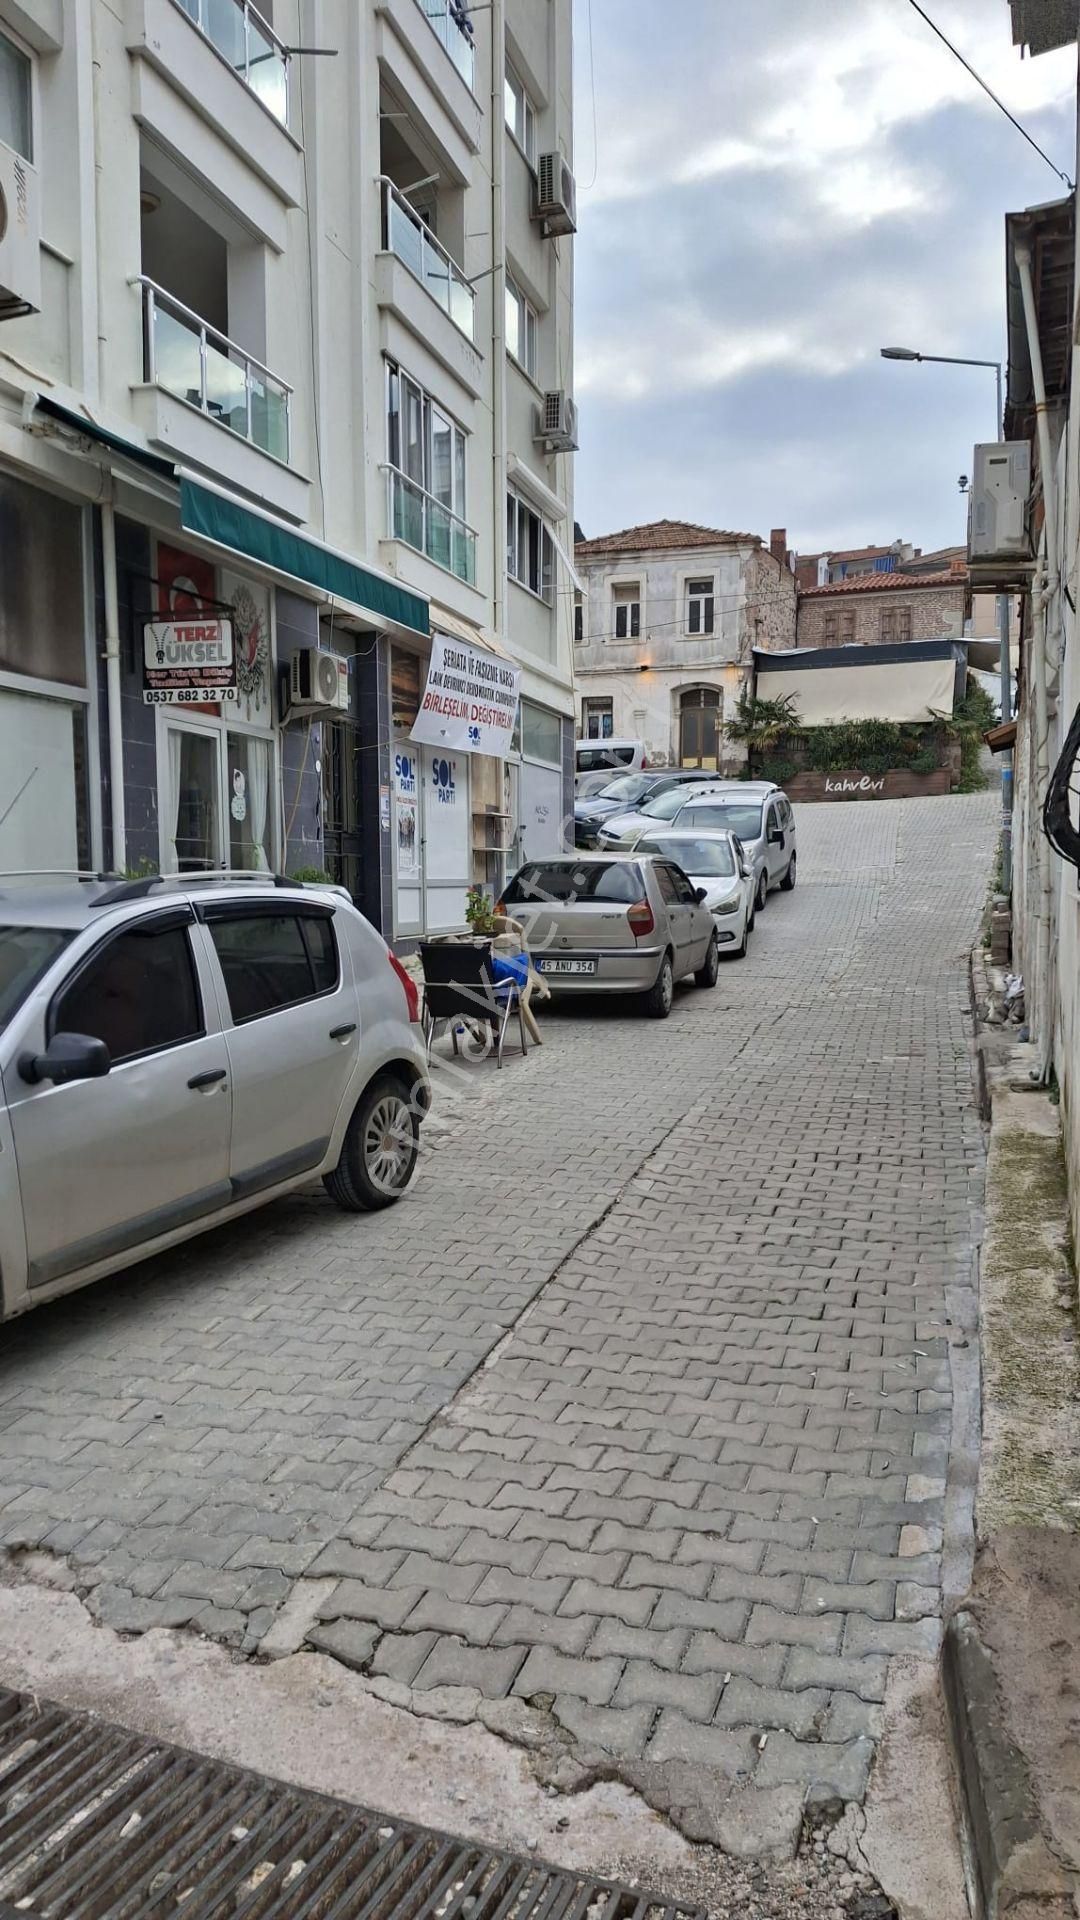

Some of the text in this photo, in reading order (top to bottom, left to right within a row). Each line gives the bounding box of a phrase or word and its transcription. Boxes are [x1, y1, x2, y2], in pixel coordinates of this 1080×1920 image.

[146, 688, 234, 702] 0537 682 32 70
[468, 726, 481, 740] SOL
[395, 754, 414, 780] SOL
[432, 758, 455, 789] SOL
[540, 960, 593, 972] 45 ANU 354
